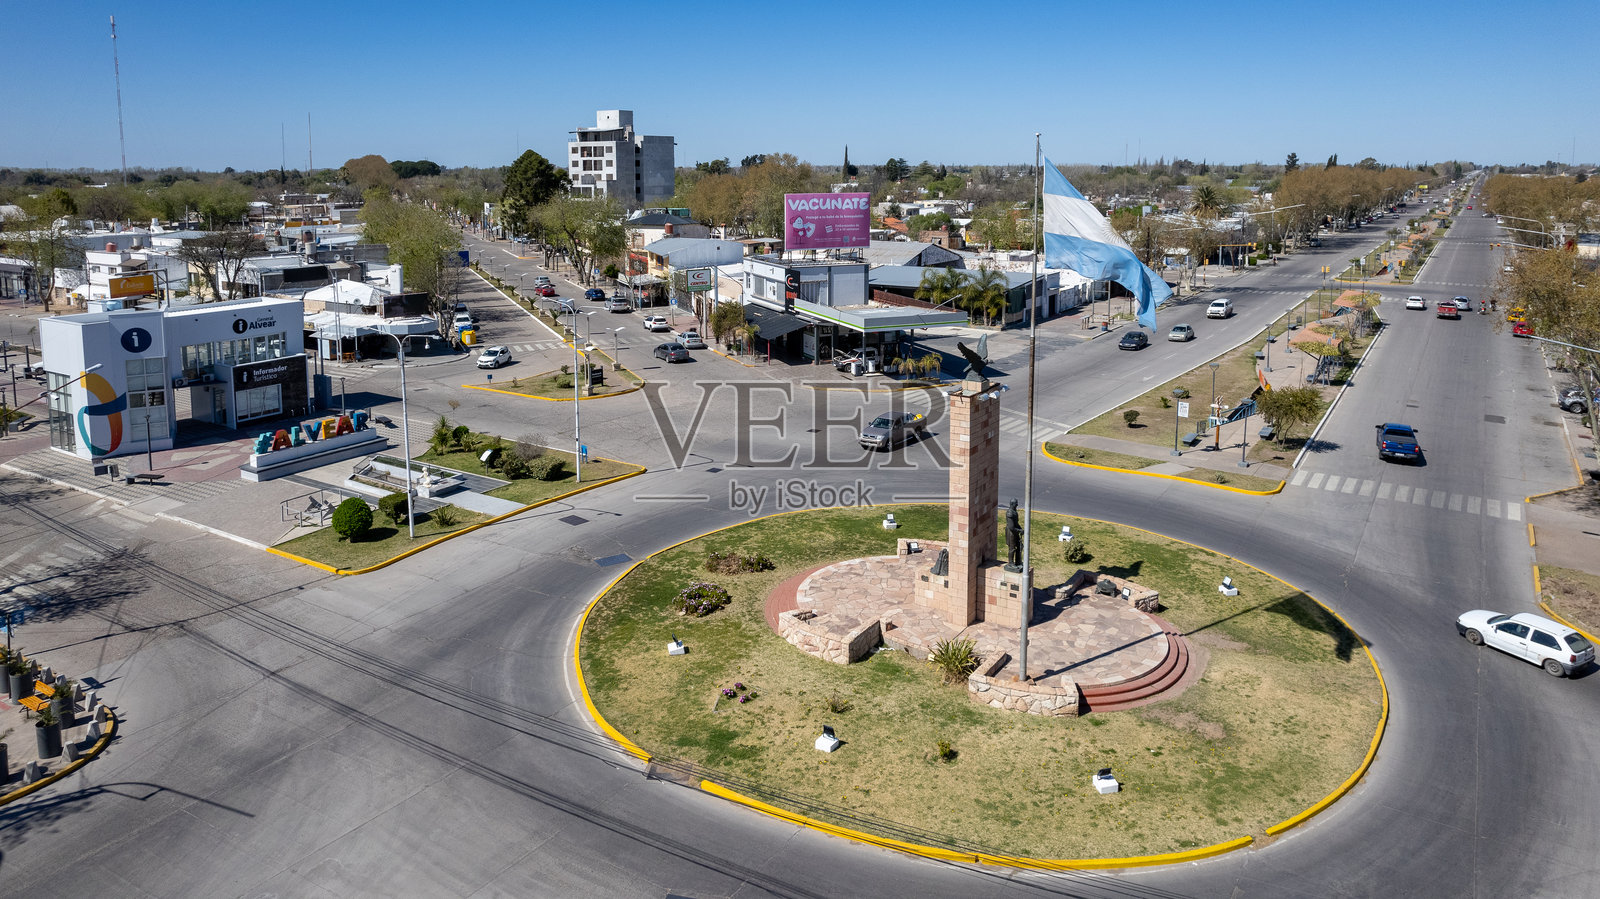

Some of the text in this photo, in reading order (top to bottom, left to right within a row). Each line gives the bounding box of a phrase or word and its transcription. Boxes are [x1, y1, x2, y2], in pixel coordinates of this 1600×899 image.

[787, 197, 870, 212] VACUNATE
[248, 320, 277, 330] Alvear
[253, 365, 288, 376] Informador
[254, 373, 278, 382] Turístico
[252, 411, 369, 455] #ALVEAR
